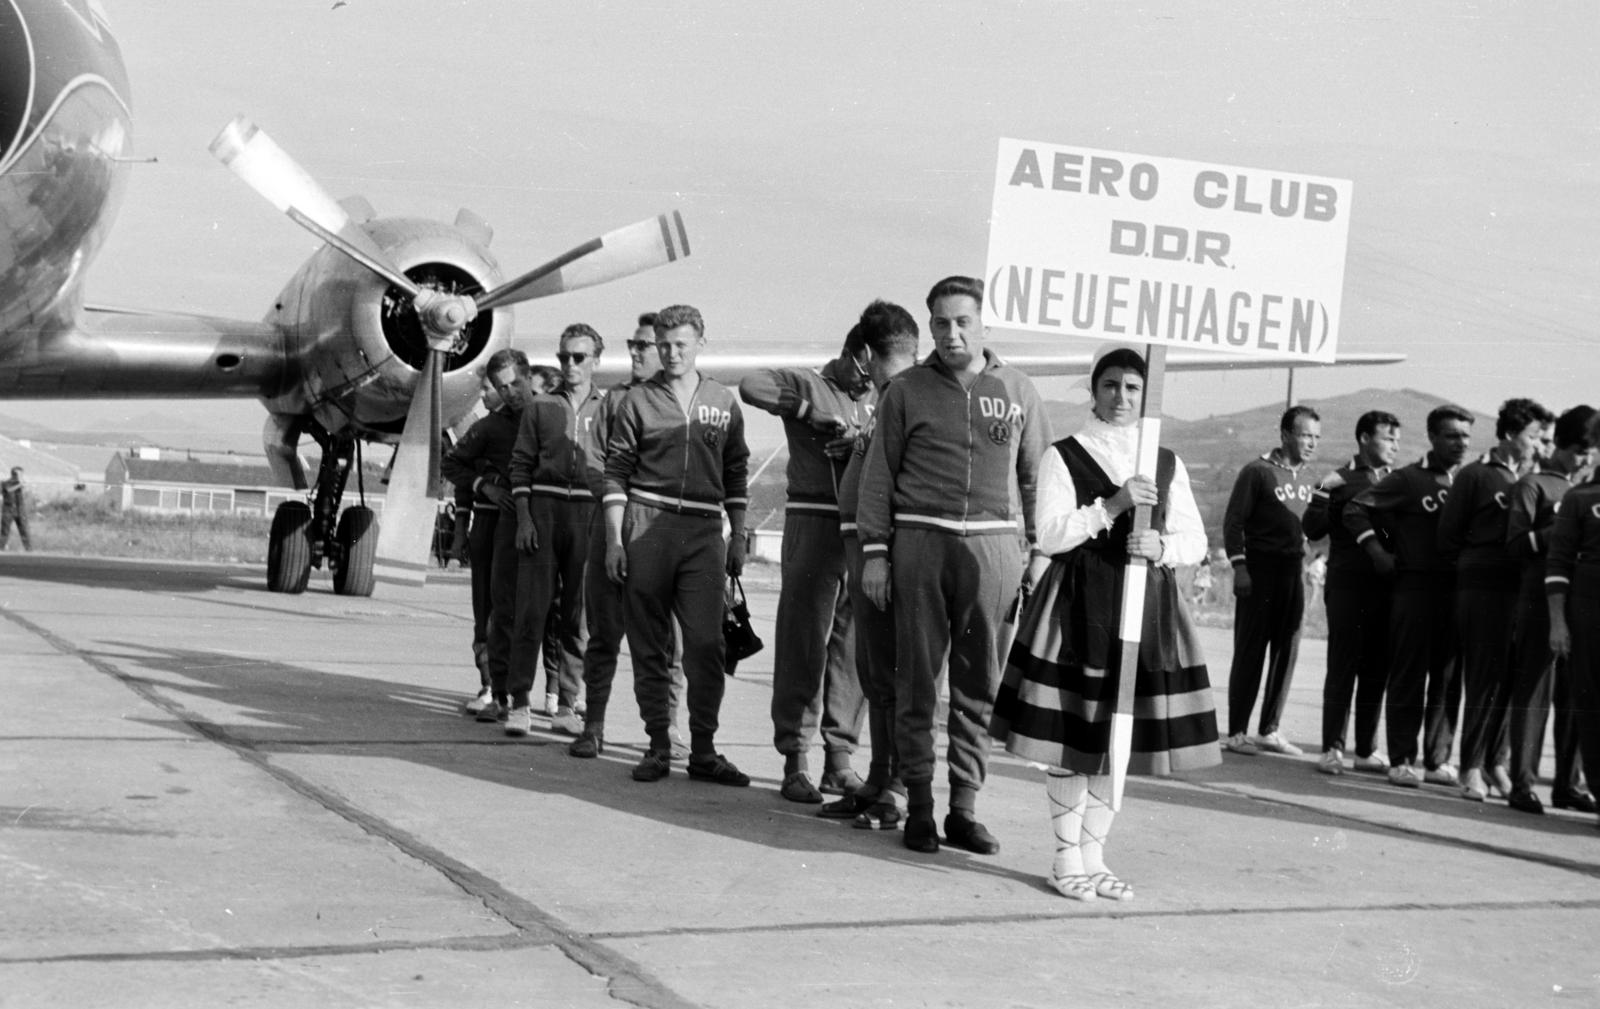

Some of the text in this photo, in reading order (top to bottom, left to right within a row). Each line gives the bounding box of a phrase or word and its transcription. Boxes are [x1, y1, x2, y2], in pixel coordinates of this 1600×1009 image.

[1008, 148, 1339, 222] AERO CLUB
[1109, 219, 1236, 270] D.D.R.
[988, 264, 1330, 354] (NEUENHAGEN)
[698, 404, 731, 432] DDR
[979, 396, 1021, 424] DDR
